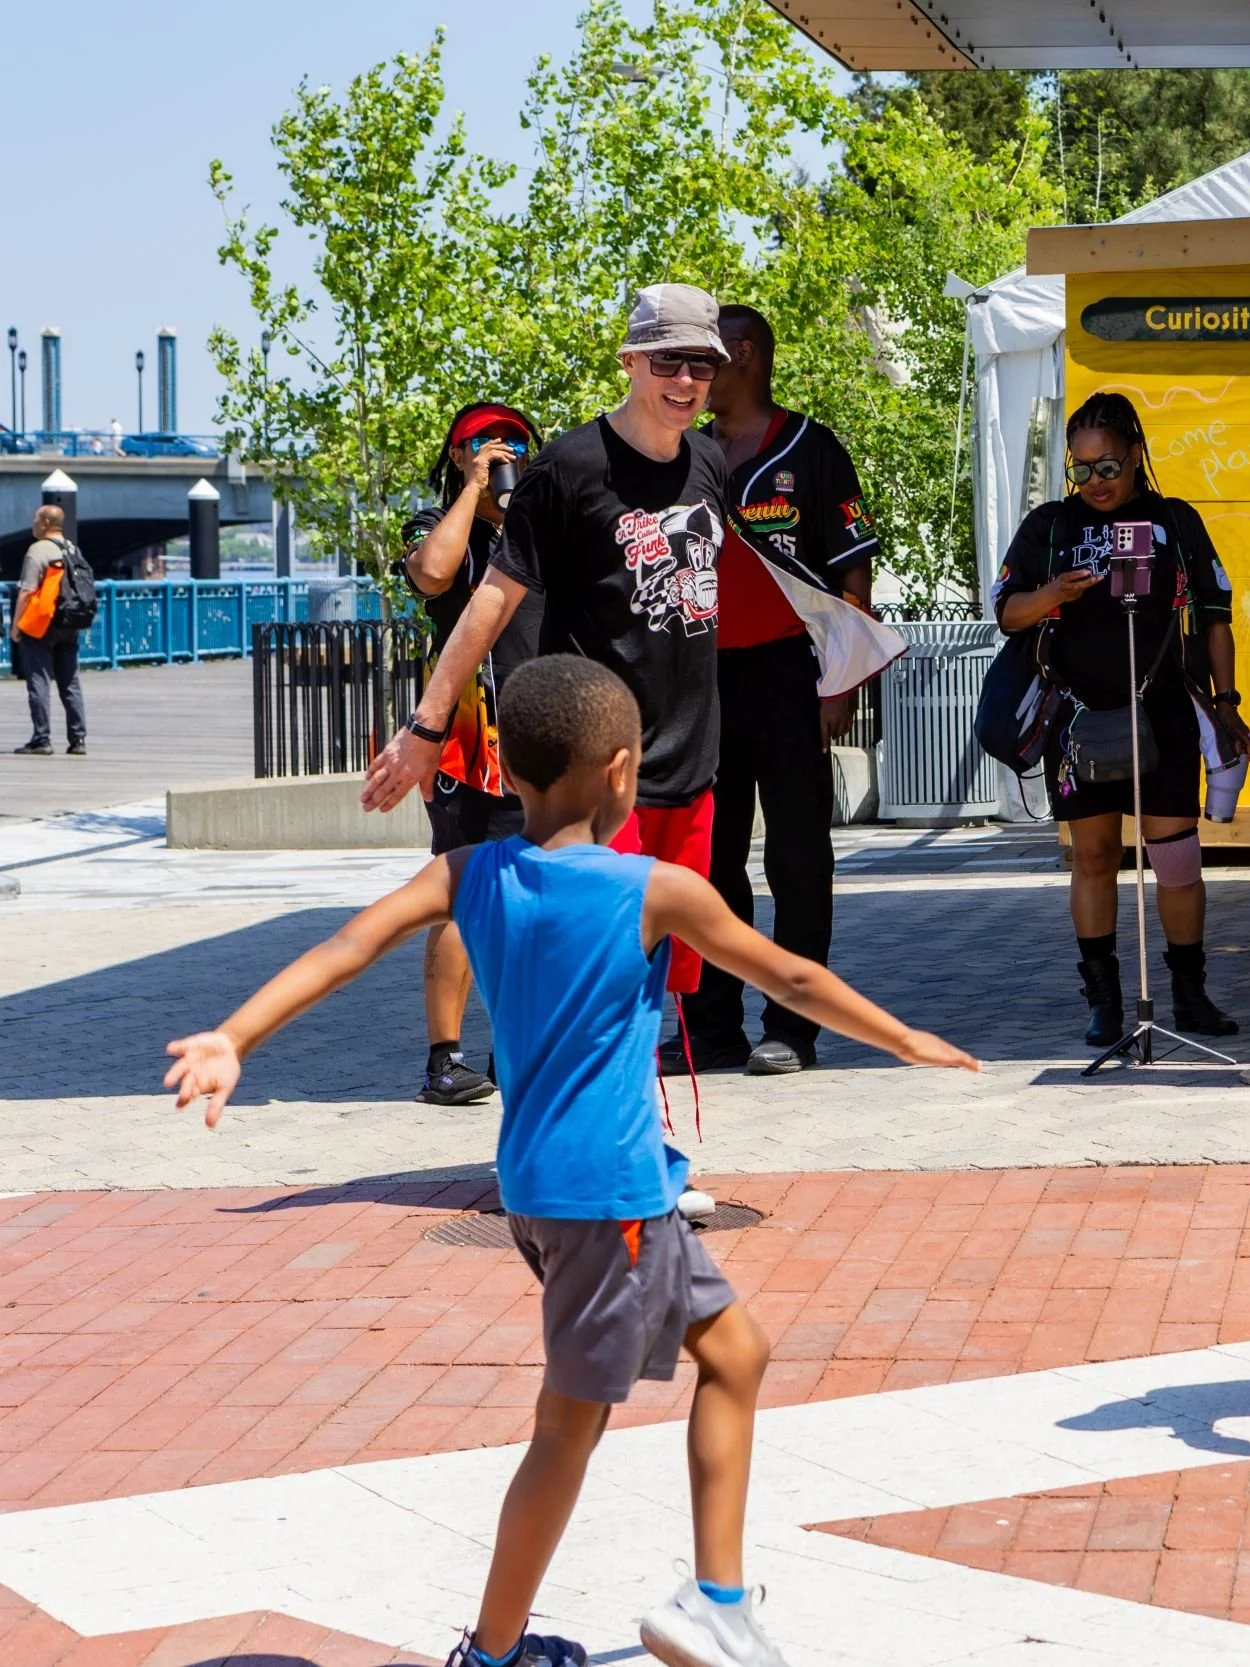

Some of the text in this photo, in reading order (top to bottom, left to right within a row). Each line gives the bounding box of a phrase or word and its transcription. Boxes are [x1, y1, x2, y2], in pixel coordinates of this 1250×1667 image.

[1147, 419, 1228, 461] Come
[622, 510, 659, 536] Trike
[626, 534, 670, 568] Funk
[768, 533, 797, 557] 35
